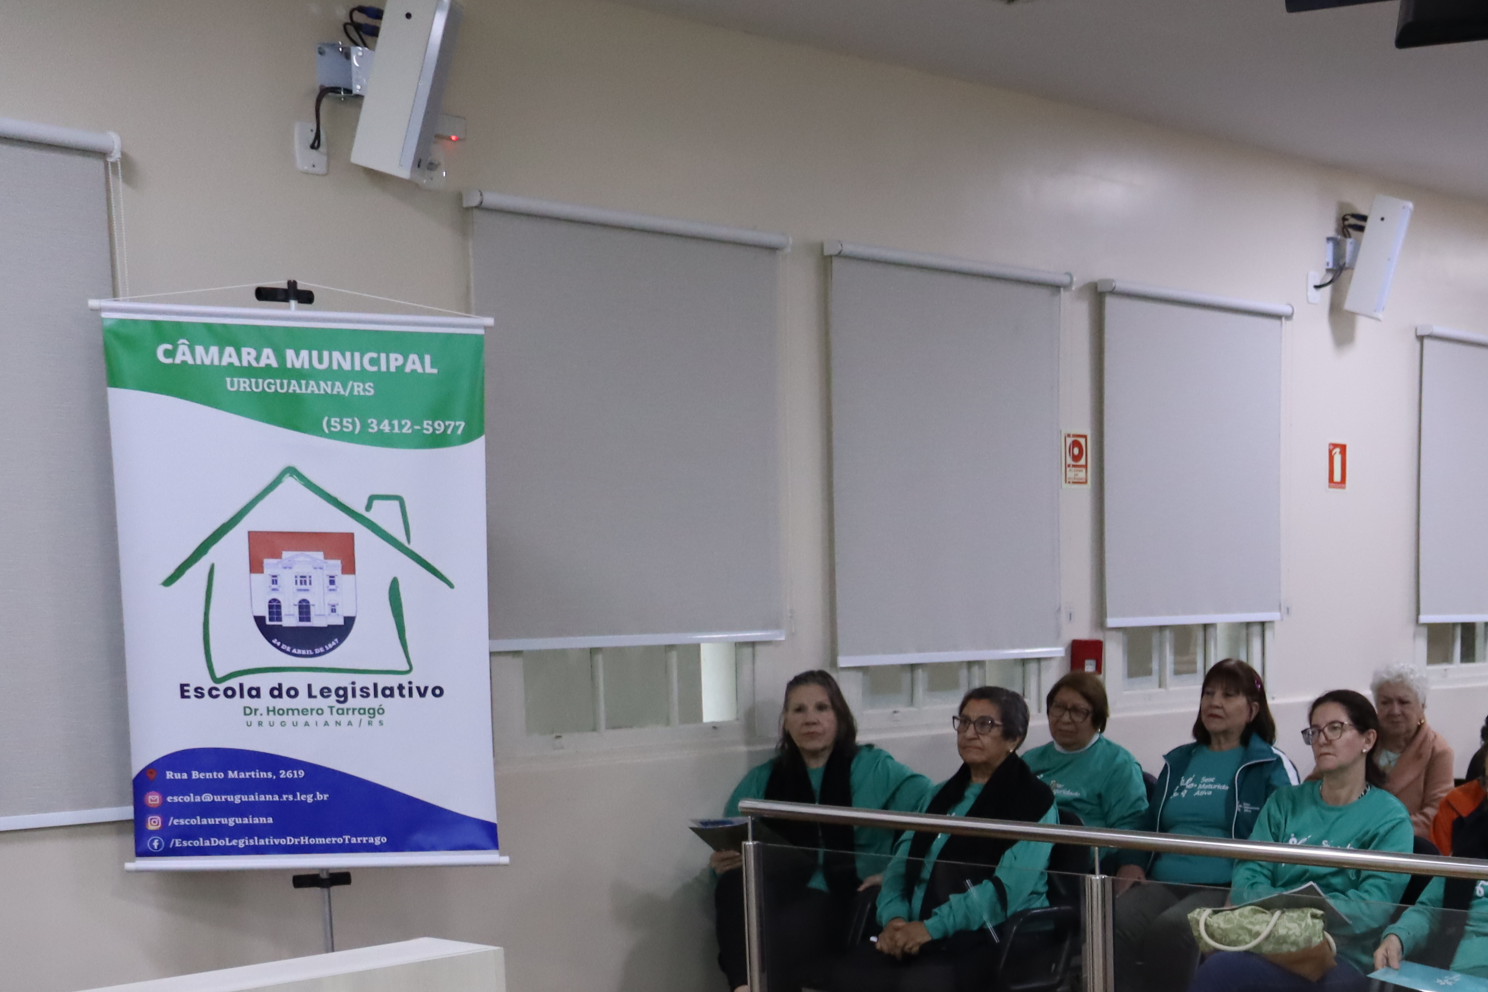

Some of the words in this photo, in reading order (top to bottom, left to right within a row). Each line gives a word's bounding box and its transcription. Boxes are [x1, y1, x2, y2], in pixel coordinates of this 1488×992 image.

[156, 338, 278, 368] CÂMARA
[286, 349, 438, 374] MUNICIPAL
[225, 377, 375, 396] URUGUAIANA/RS
[322, 417, 361, 435] (55)
[367, 418, 466, 436] 3412-5977
[280, 643, 291, 652] DE
[291, 647, 314, 655] ABRIL
[314, 646, 325, 654] DE
[178, 681, 262, 700] Escola
[268, 681, 300, 700] do
[307, 681, 445, 704] Legislativo
[243, 705, 263, 717] Dr.
[266, 705, 325, 717] Homero
[328, 704, 386, 719] Tarragó
[165, 769, 189, 781] Rua
[191, 768, 225, 780] Bento
[228, 768, 276, 782] Martins,
[279, 769, 306, 780] 2619
[166, 791, 330, 805] escola@uruguaiana.rs.leg.br
[167, 813, 274, 827] /escolauruguaiana
[169, 833, 388, 849] /EscolaDoLegislativoDrHomeroTarrago
